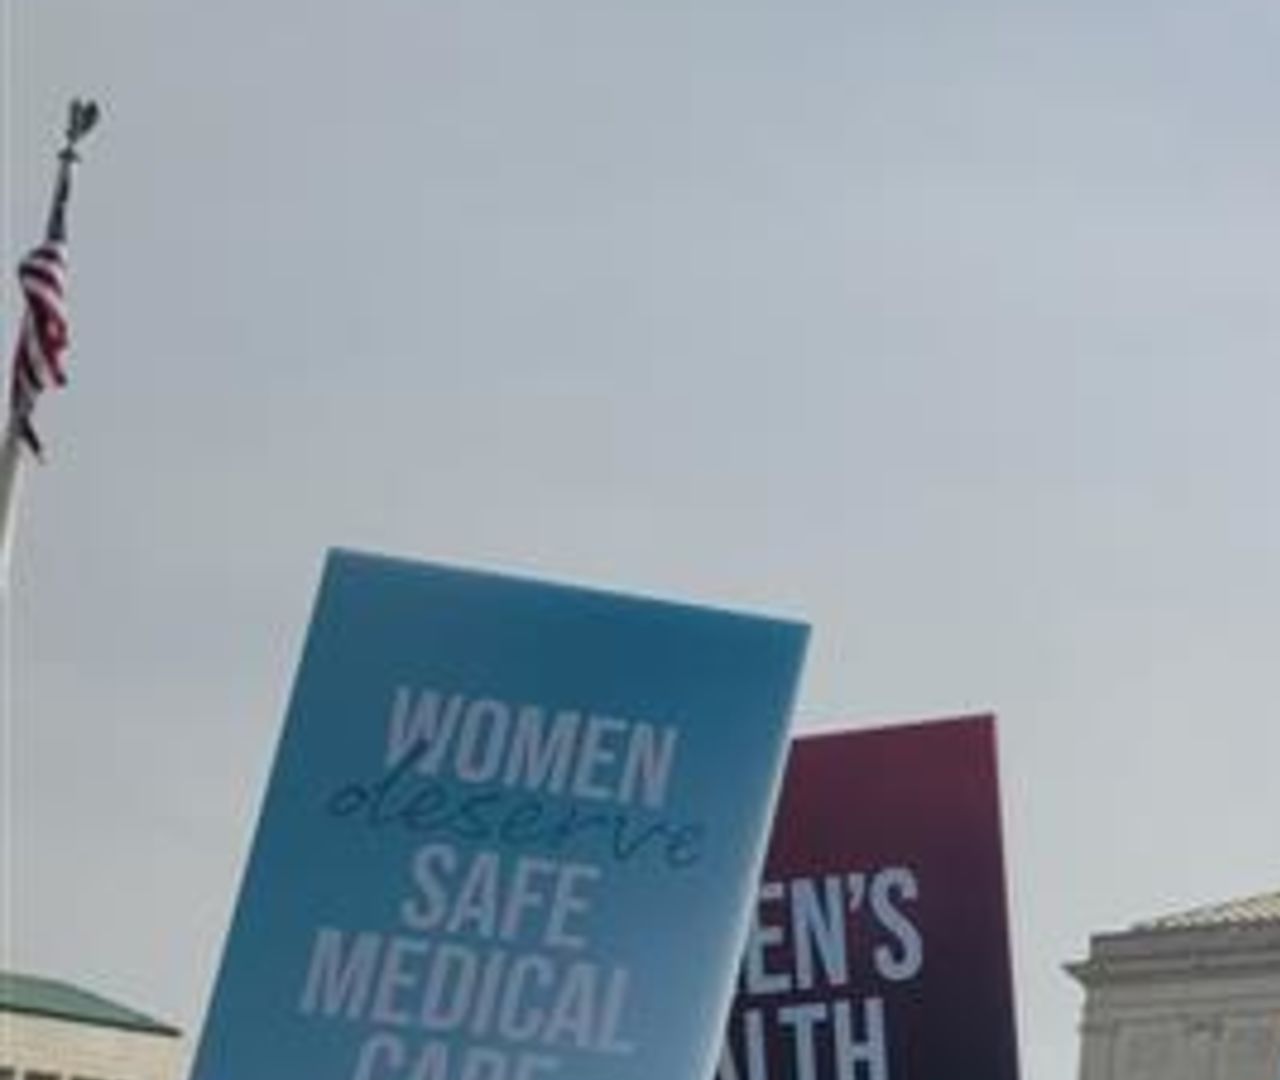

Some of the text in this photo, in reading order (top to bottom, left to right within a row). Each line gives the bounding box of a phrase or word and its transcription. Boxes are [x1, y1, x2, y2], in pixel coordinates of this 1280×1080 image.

[330, 740, 704, 869] deserve
[383, 687, 679, 810] WOMEN
[401, 844, 601, 951] SAFE
[742, 866, 923, 995] EN'S
[299, 930, 639, 1056] MEDICAL
